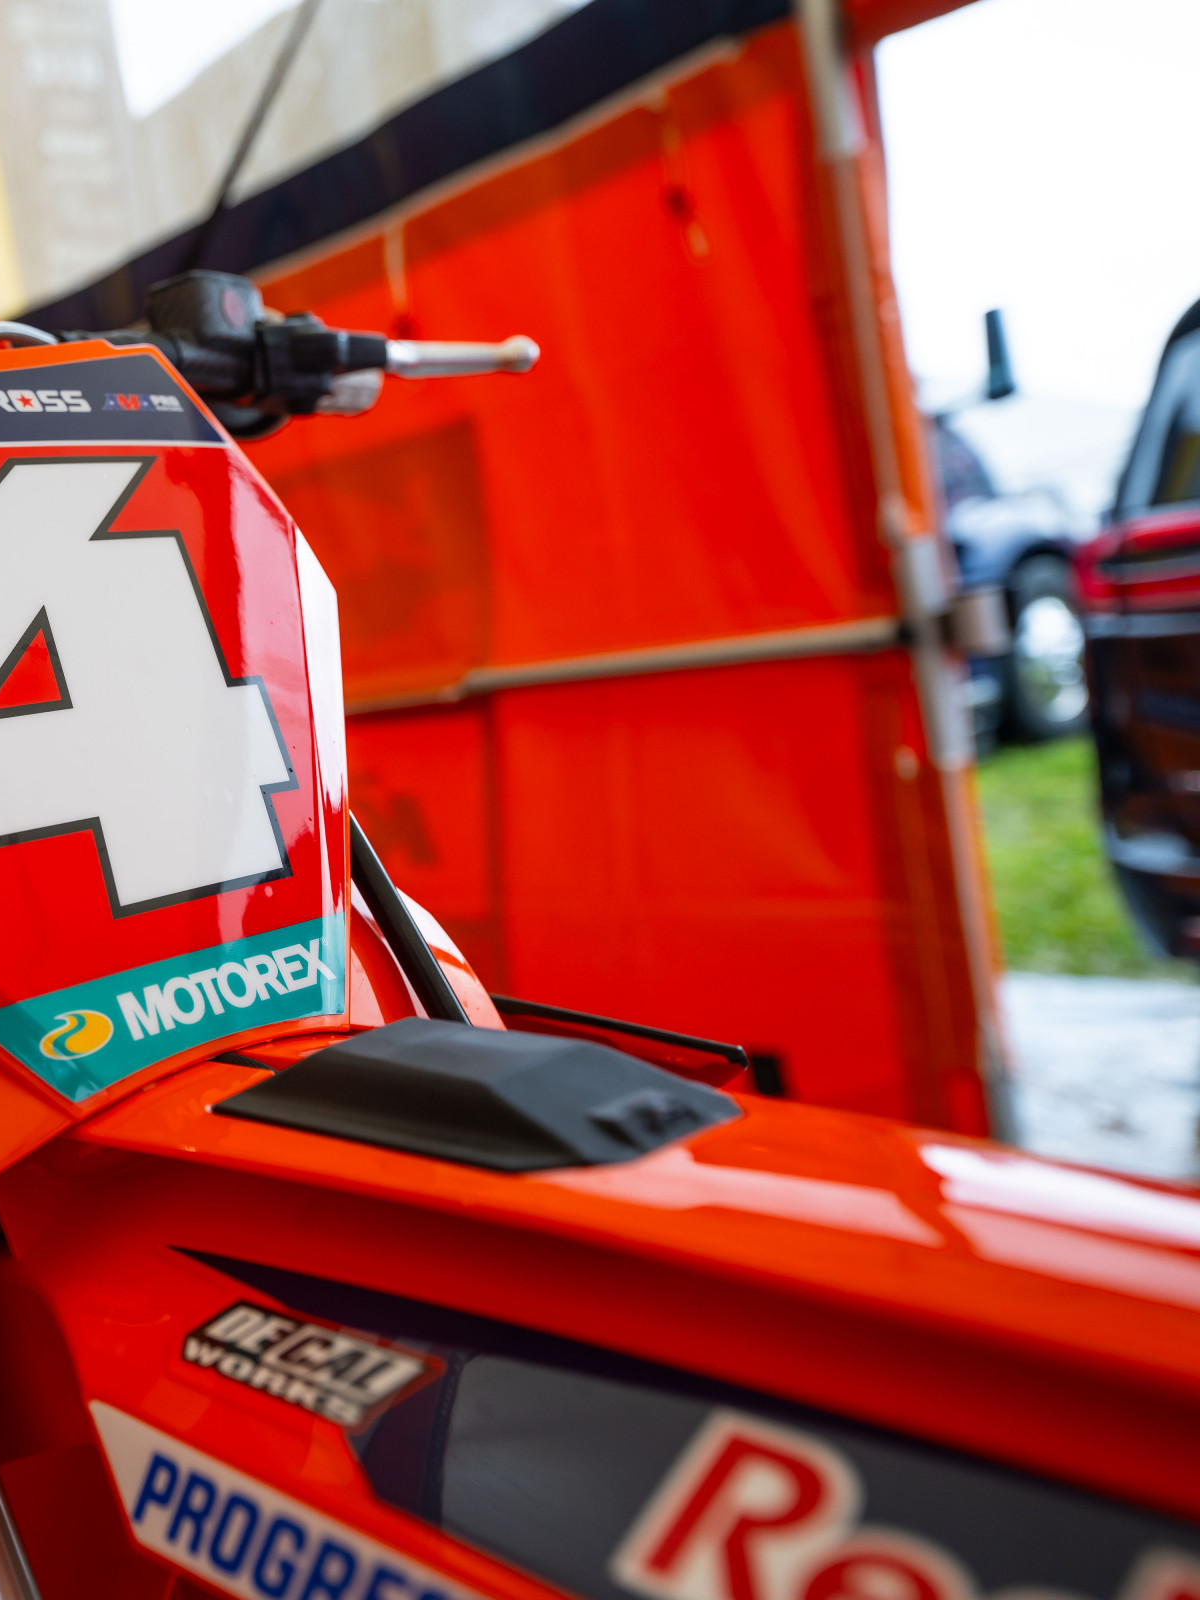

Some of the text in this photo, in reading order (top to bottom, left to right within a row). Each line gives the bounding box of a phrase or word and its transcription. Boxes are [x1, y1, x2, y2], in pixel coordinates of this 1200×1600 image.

[115, 938, 336, 1041] MOTOREX
[182, 1337, 366, 1427] WORKS
[203, 1303, 426, 1395] DECAL
[132, 1451, 458, 1600] PROGR
